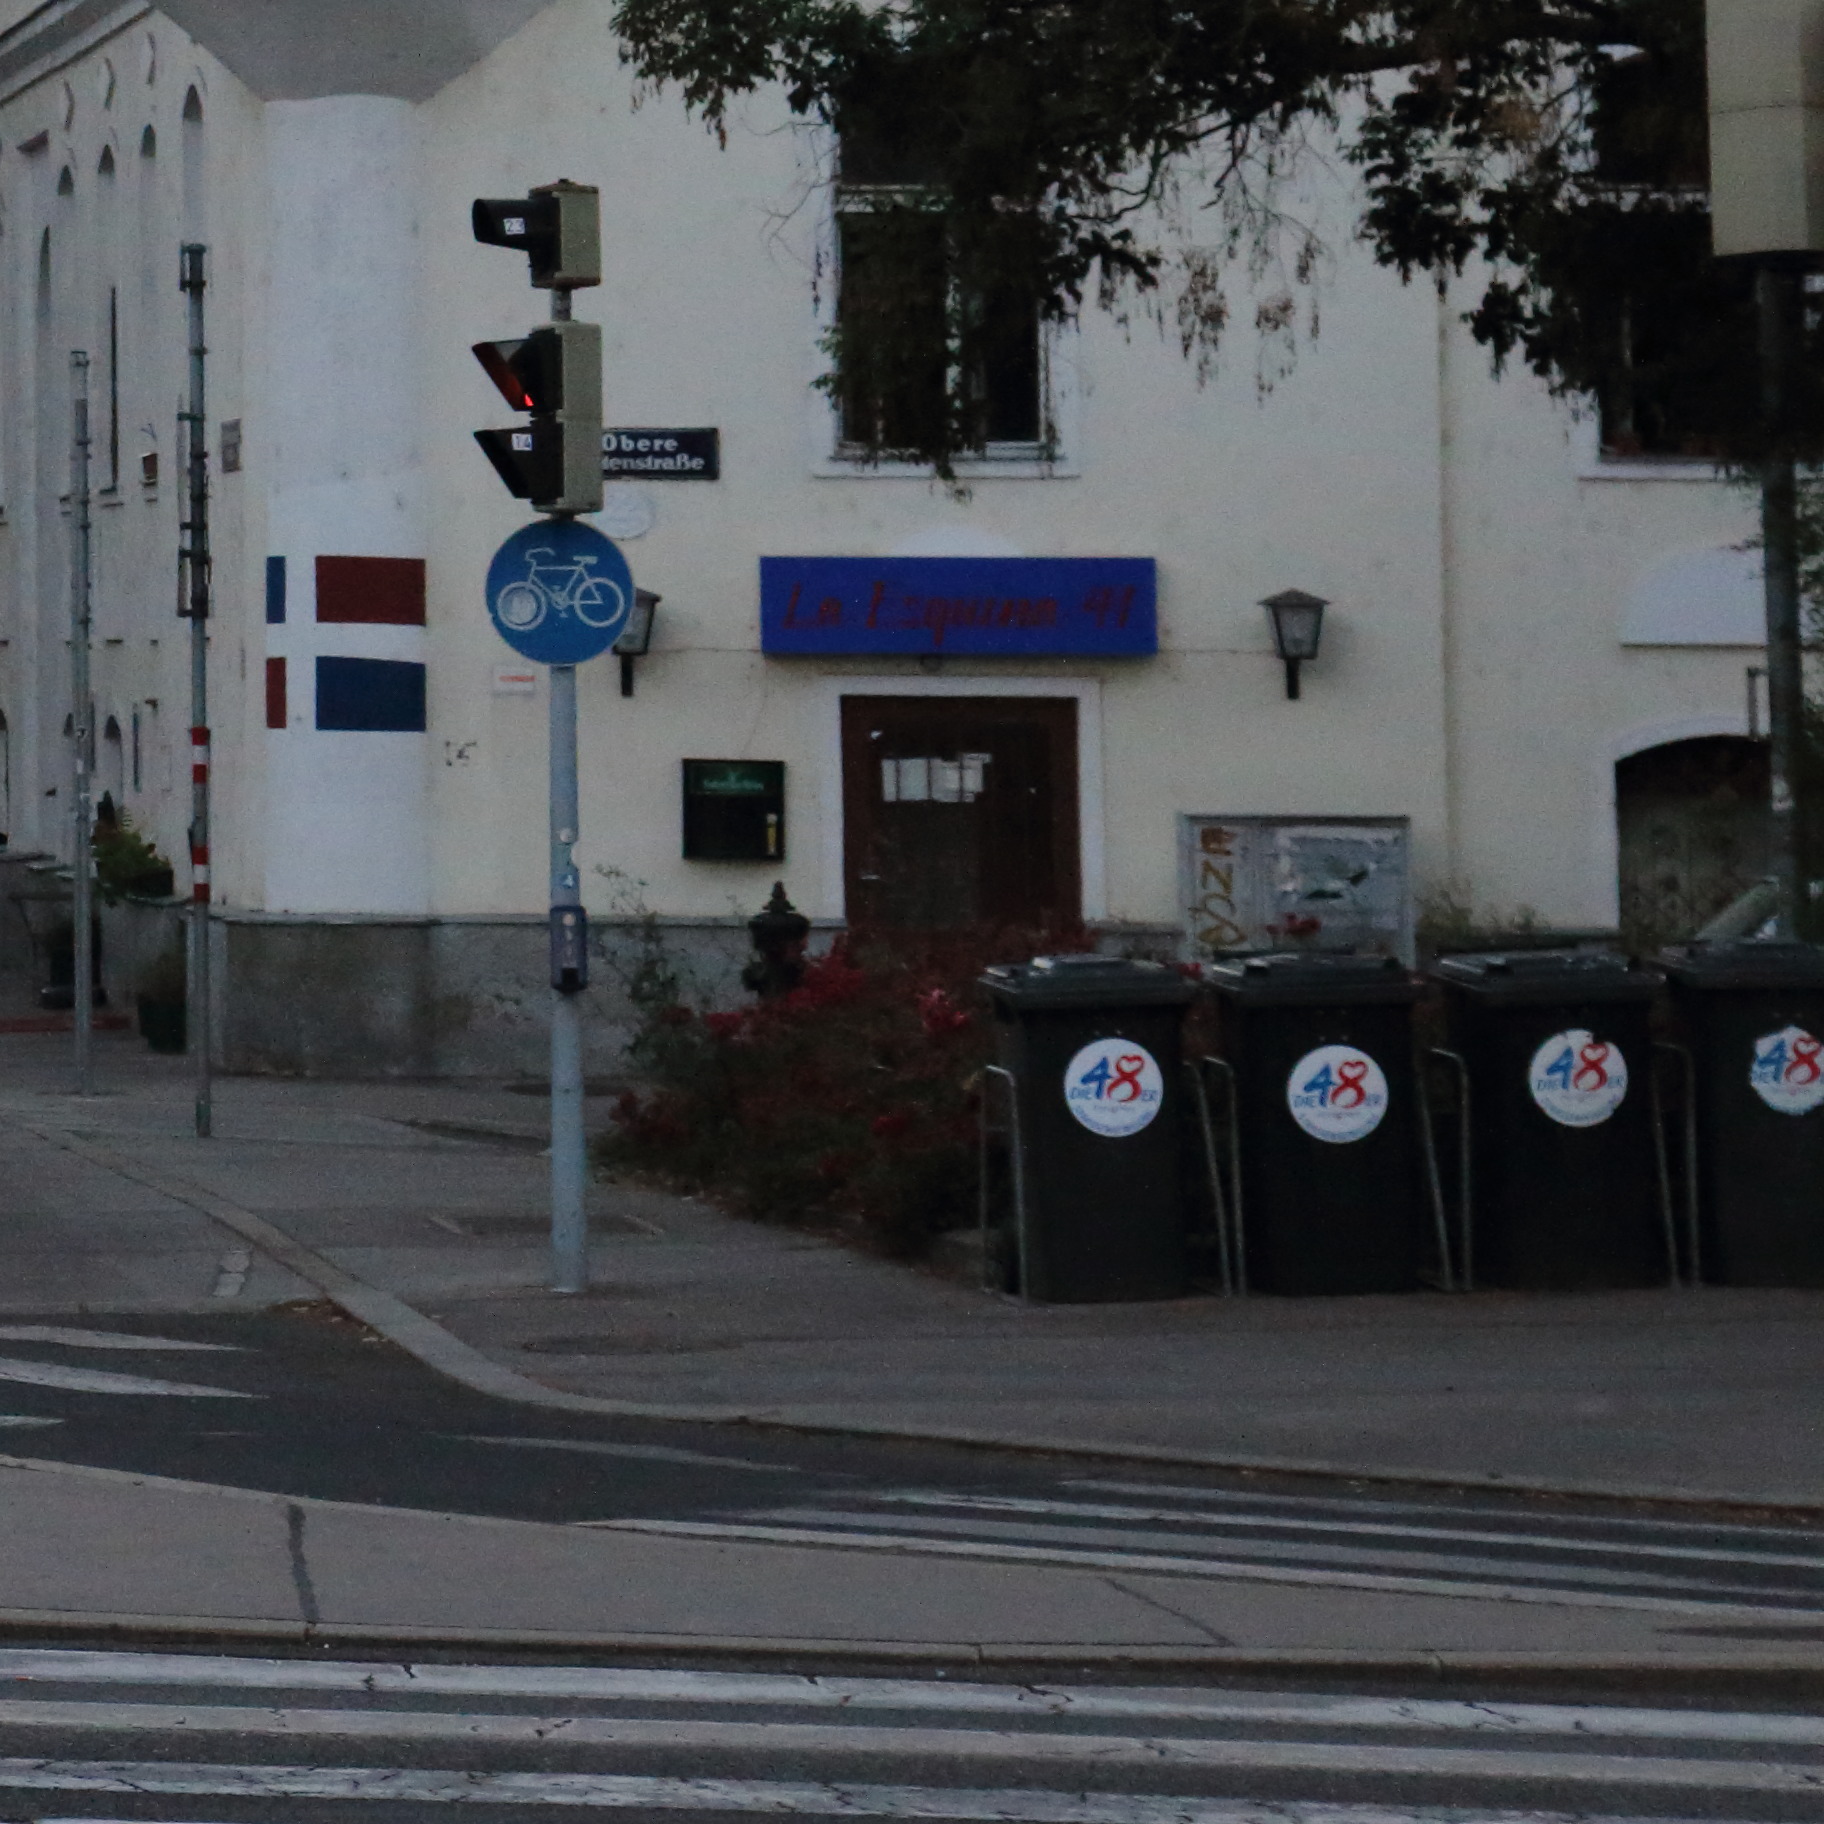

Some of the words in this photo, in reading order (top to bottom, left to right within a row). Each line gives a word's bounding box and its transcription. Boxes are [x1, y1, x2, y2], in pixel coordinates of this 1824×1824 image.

[515, 435, 531, 449] 14
[601, 432, 679, 452] Obere
[601, 452, 706, 471] tenstraße
[782, 579, 842, 630] La
[1081, 1055, 1145, 1103] 48
[1303, 1060, 1369, 1109] 48
[1546, 1043, 1610, 1092] 48
